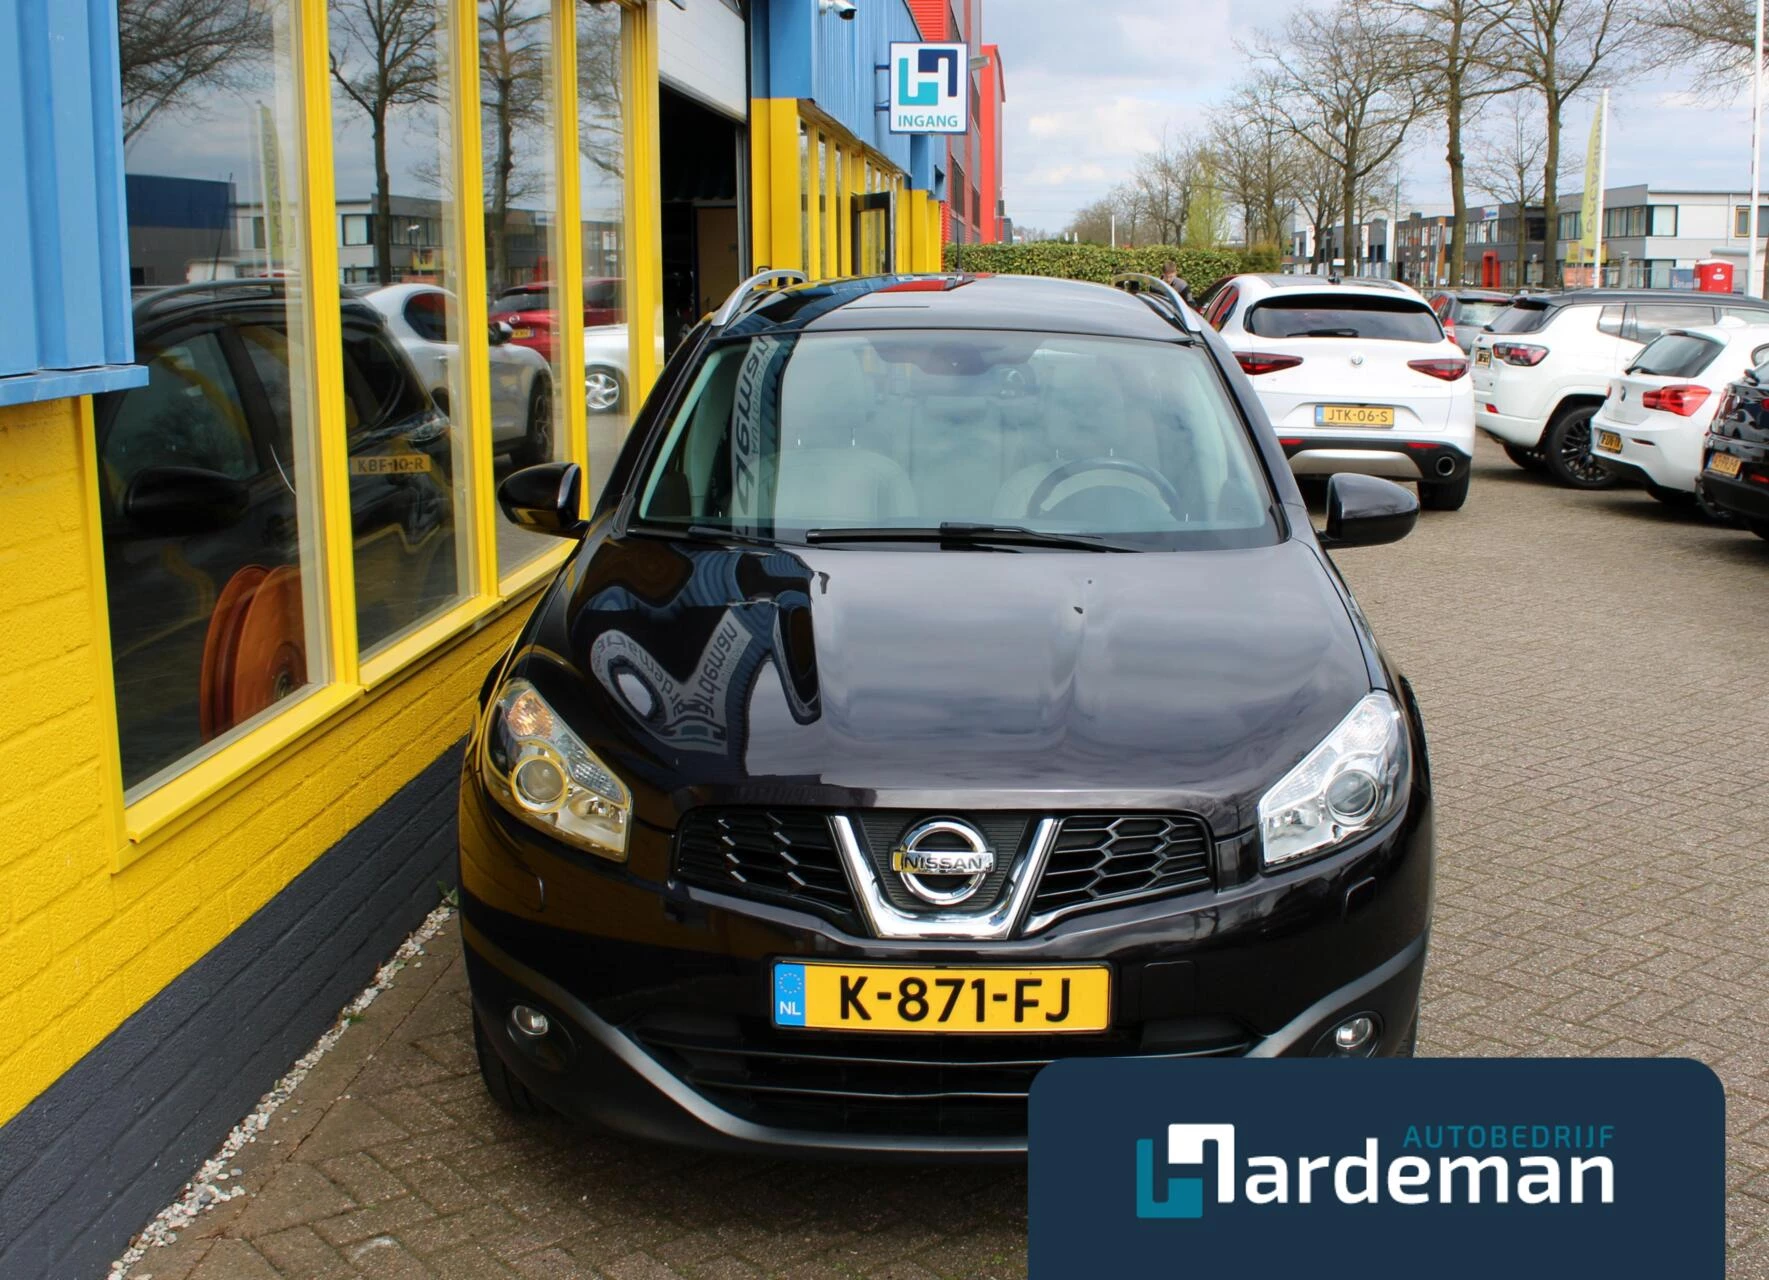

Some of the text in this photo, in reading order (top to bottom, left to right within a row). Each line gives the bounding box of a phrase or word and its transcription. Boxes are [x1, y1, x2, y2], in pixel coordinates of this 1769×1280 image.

[898, 115, 958, 127] INGANG
[1328, 409, 1388, 422] JTK-06-S
[358, 458, 424, 472] KBF-10-R
[903, 855, 982, 870] NISSAN
[780, 975, 1071, 1023] NL K-871-FJ
